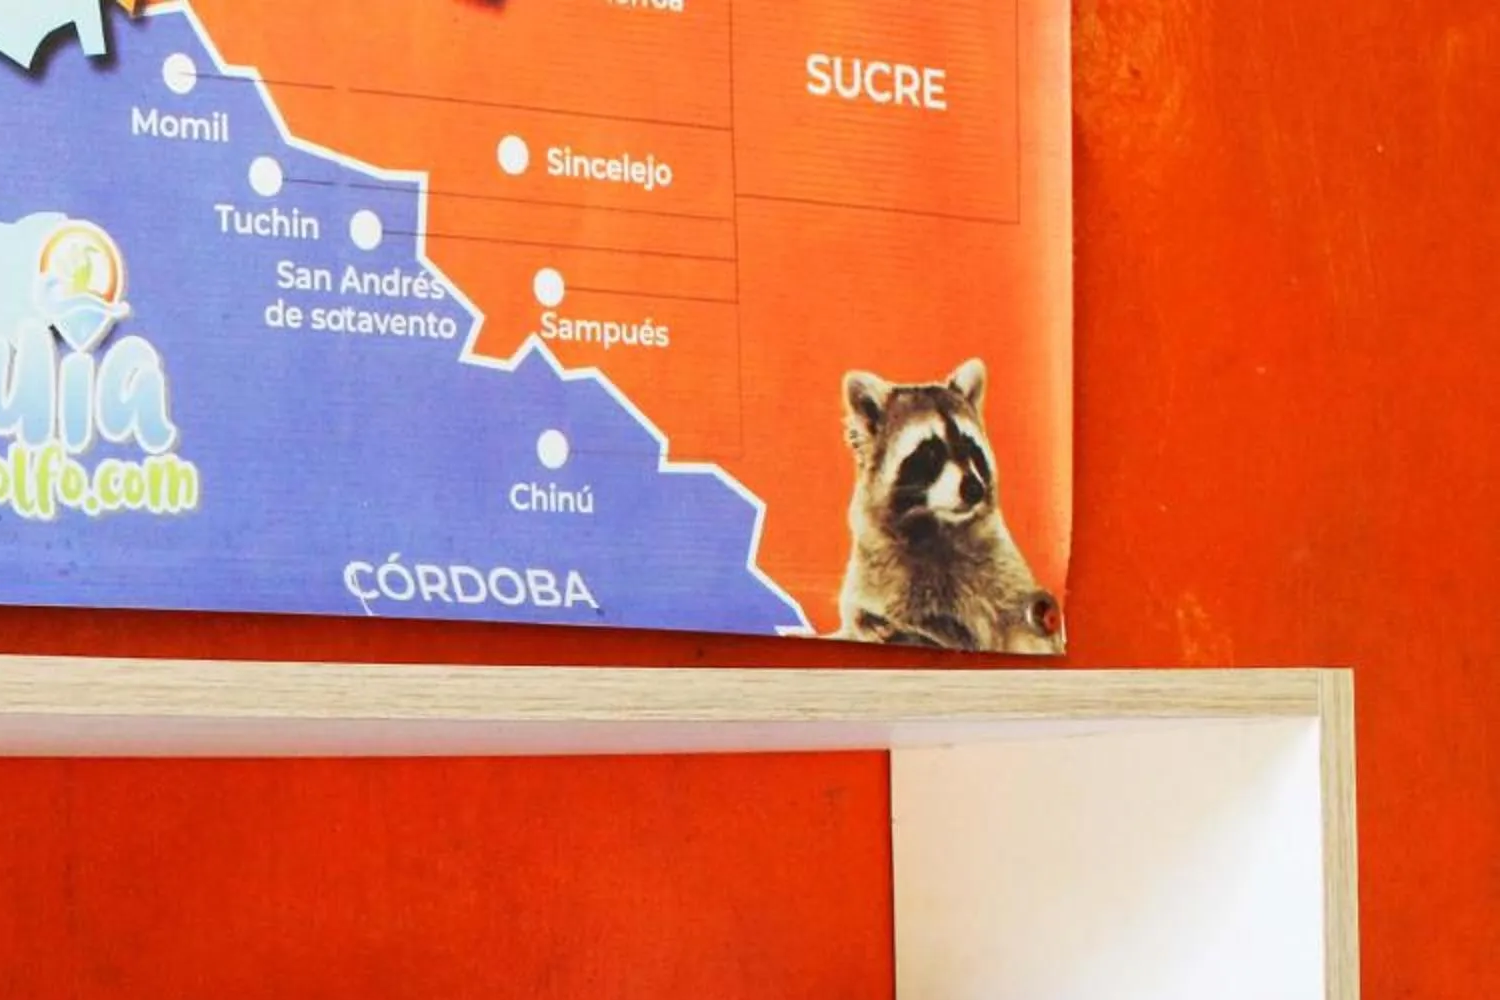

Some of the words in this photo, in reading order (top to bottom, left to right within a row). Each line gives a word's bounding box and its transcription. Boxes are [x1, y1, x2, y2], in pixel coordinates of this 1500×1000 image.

[806, 54, 947, 110] SUCRE
[131, 107, 229, 143] Momil
[546, 147, 673, 191] Sincelejo
[215, 204, 319, 240] Tuchin
[276, 260, 332, 293] San
[339, 265, 445, 301] Andrés
[264, 300, 302, 329] de
[311, 305, 457, 340] sotavento
[540, 311, 670, 349] Sampués
[509, 483, 594, 514] Chinú
[343, 553, 598, 611] CÓRDOBA
